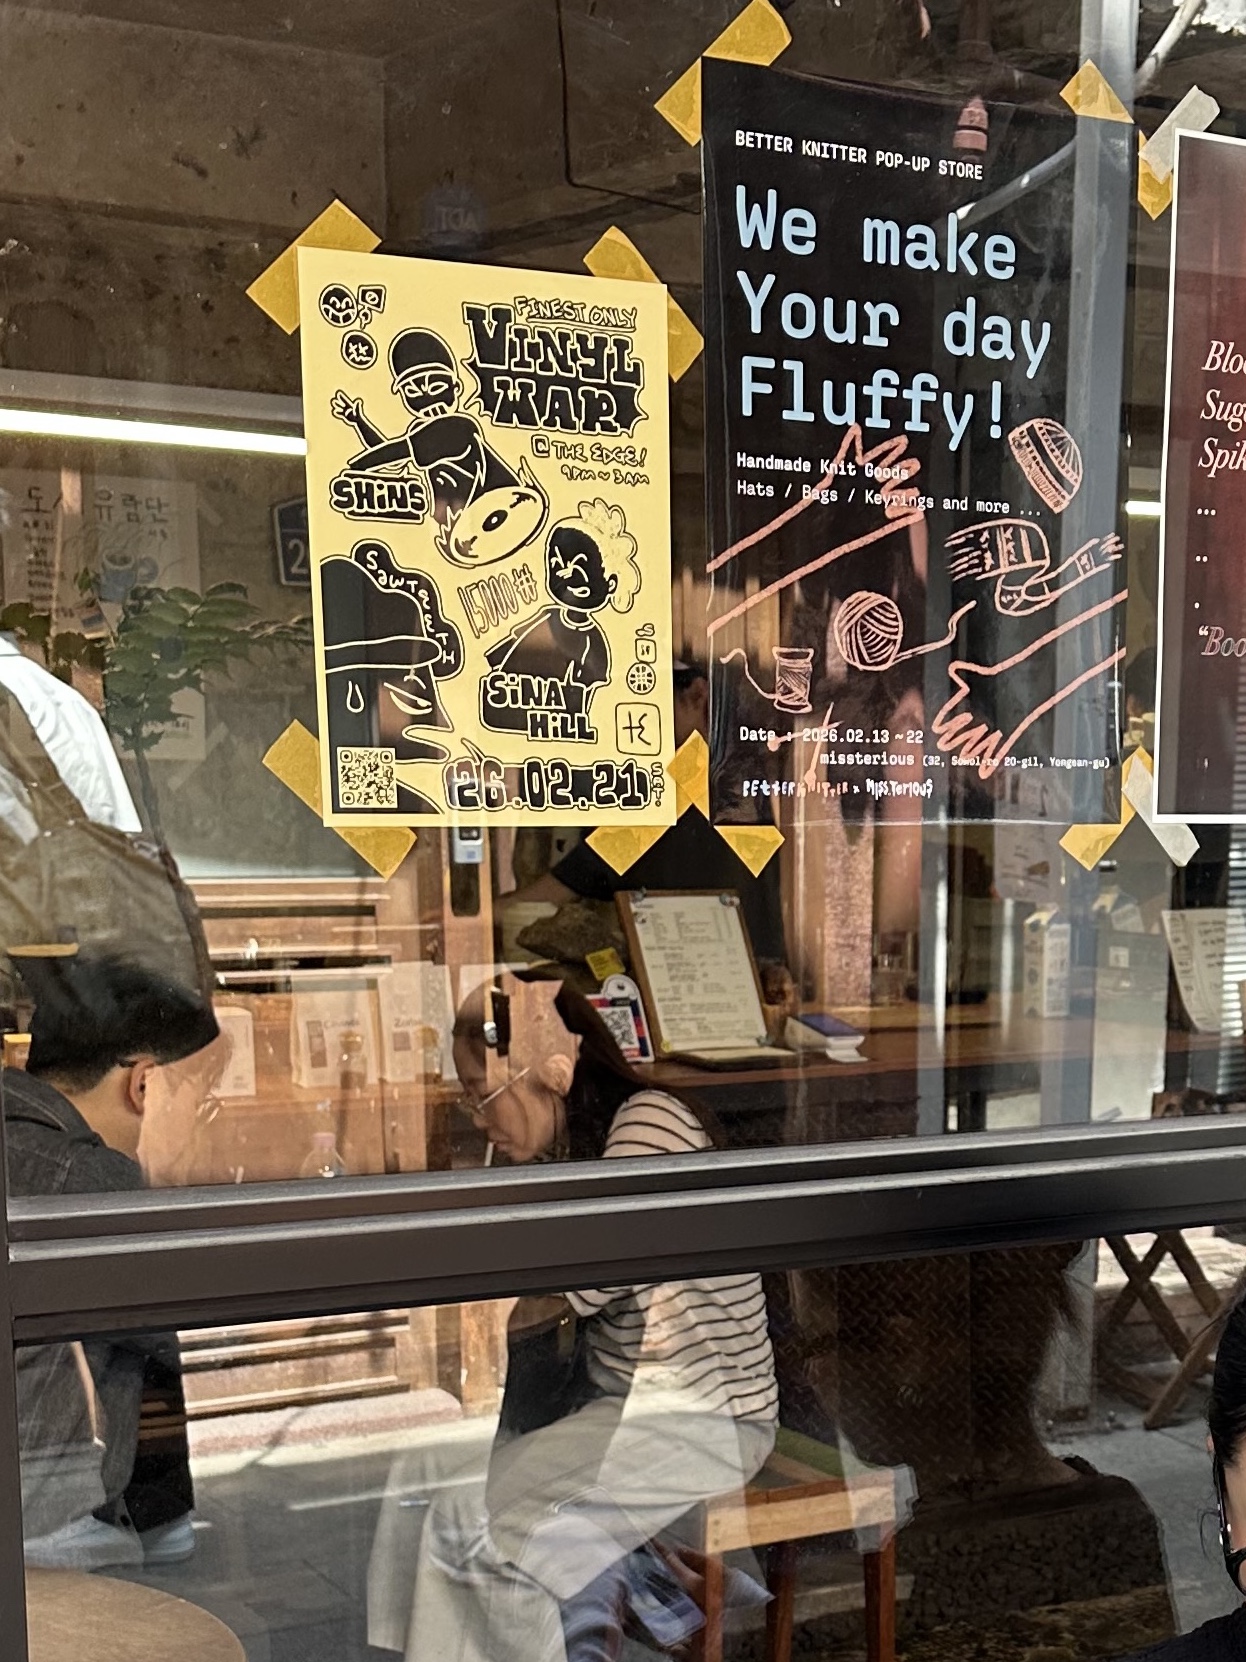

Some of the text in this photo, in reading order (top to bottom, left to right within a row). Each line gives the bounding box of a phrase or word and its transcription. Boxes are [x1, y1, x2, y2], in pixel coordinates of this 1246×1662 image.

[735, 129, 983, 180] BETTER KNITTER POP-UP STORE
[735, 185, 1017, 281] We make
[514, 296, 637, 328] FINEST ONLY
[736, 271, 1052, 380] Your day
[463, 302, 645, 388] VINYL
[492, 376, 622, 435] WAR
[741, 356, 1003, 451] Fluffy!
[551, 441, 588, 462] THE
[590, 443, 647, 467] EDGE!
[736, 452, 909, 480] Handmade Knit Goods
[737, 480, 775, 497] Hats
[802, 484, 838, 505] Bags
[865, 489, 934, 511] Keyrings
[942, 497, 968, 511] and
[976, 500, 1010, 514] more
[739, 726, 776, 743] Date
[802, 727, 890, 744] 2026.02.13
[820, 751, 915, 766] missterious
[1004, 756, 1044, 769] 20-gil,
[447, 758, 648, 811] 26.02.21
